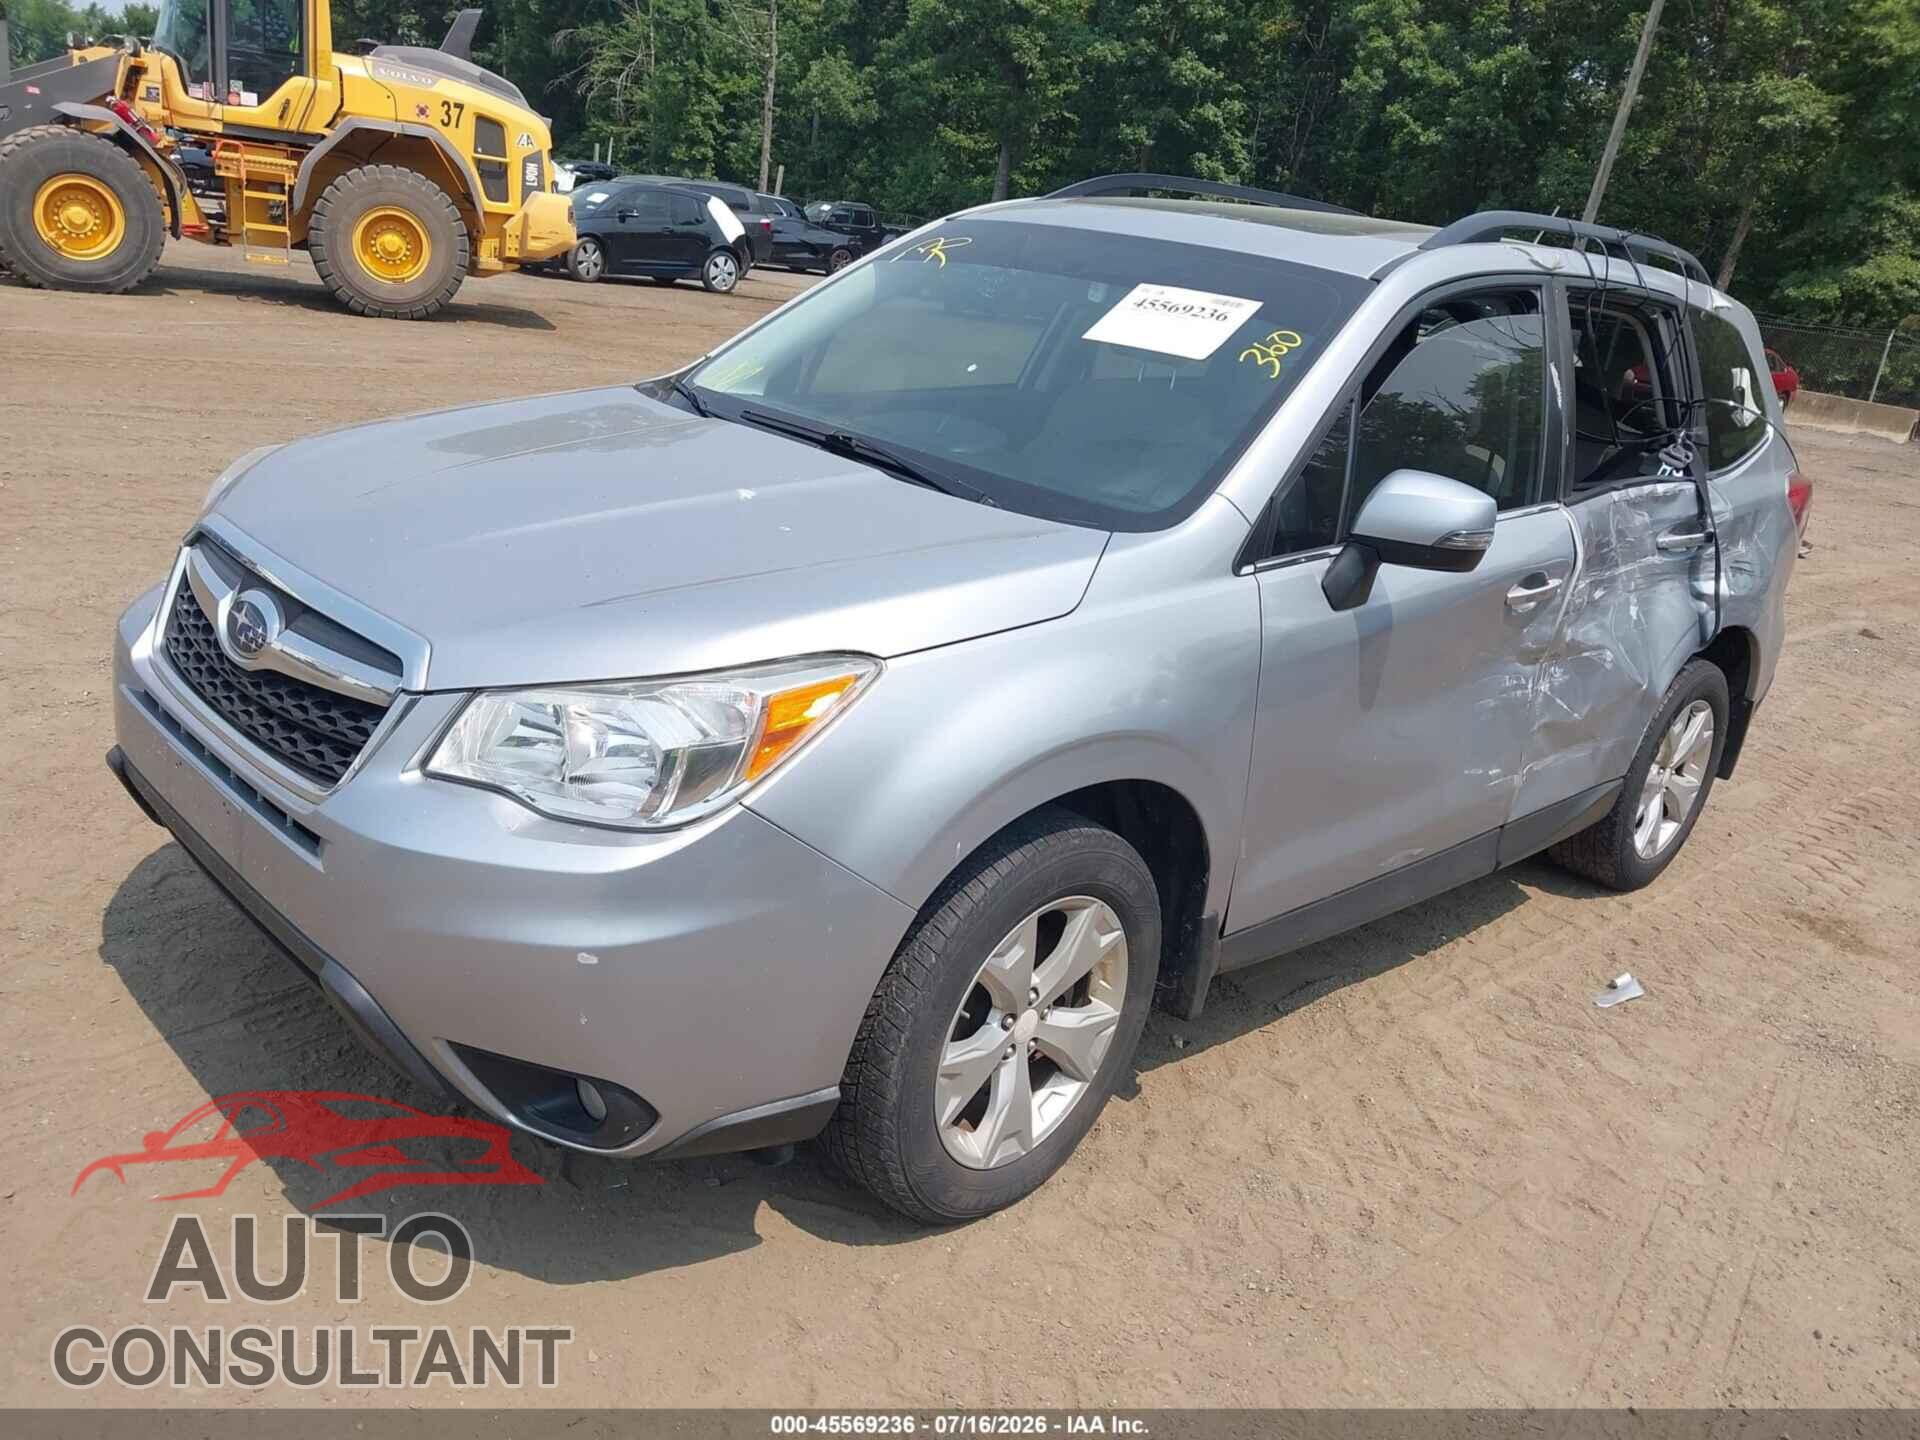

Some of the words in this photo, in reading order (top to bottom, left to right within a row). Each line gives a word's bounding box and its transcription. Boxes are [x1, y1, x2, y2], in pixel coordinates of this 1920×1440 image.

[376, 66, 433, 85] VOLVO
[440, 100, 465, 128] 37
[525, 162, 539, 186] L90H
[1133, 296, 1229, 323] 45569236
[1239, 329, 1303, 379] 360
